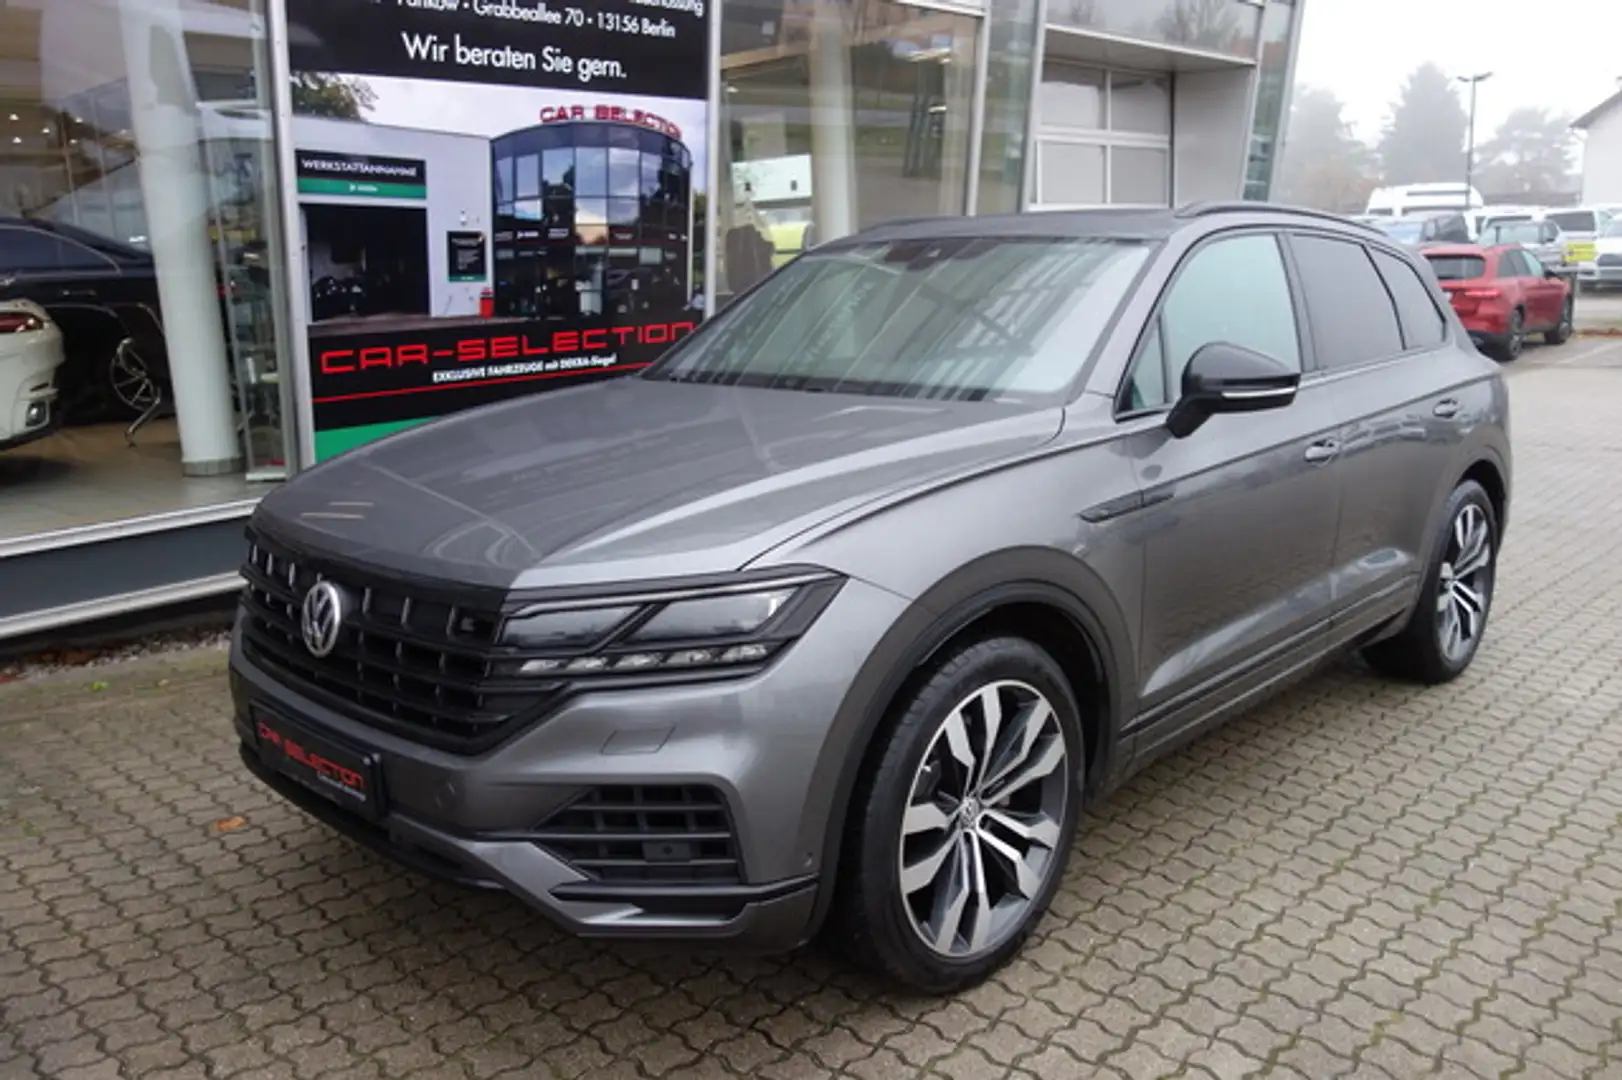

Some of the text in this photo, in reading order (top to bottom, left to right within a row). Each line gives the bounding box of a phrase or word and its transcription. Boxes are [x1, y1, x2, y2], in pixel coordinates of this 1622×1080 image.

[564, 7, 585, 28] 70
[598, 11, 639, 34] 13156
[640, 17, 676, 38] Berlin
[401, 30, 628, 83] Wir beraten Sie gern.
